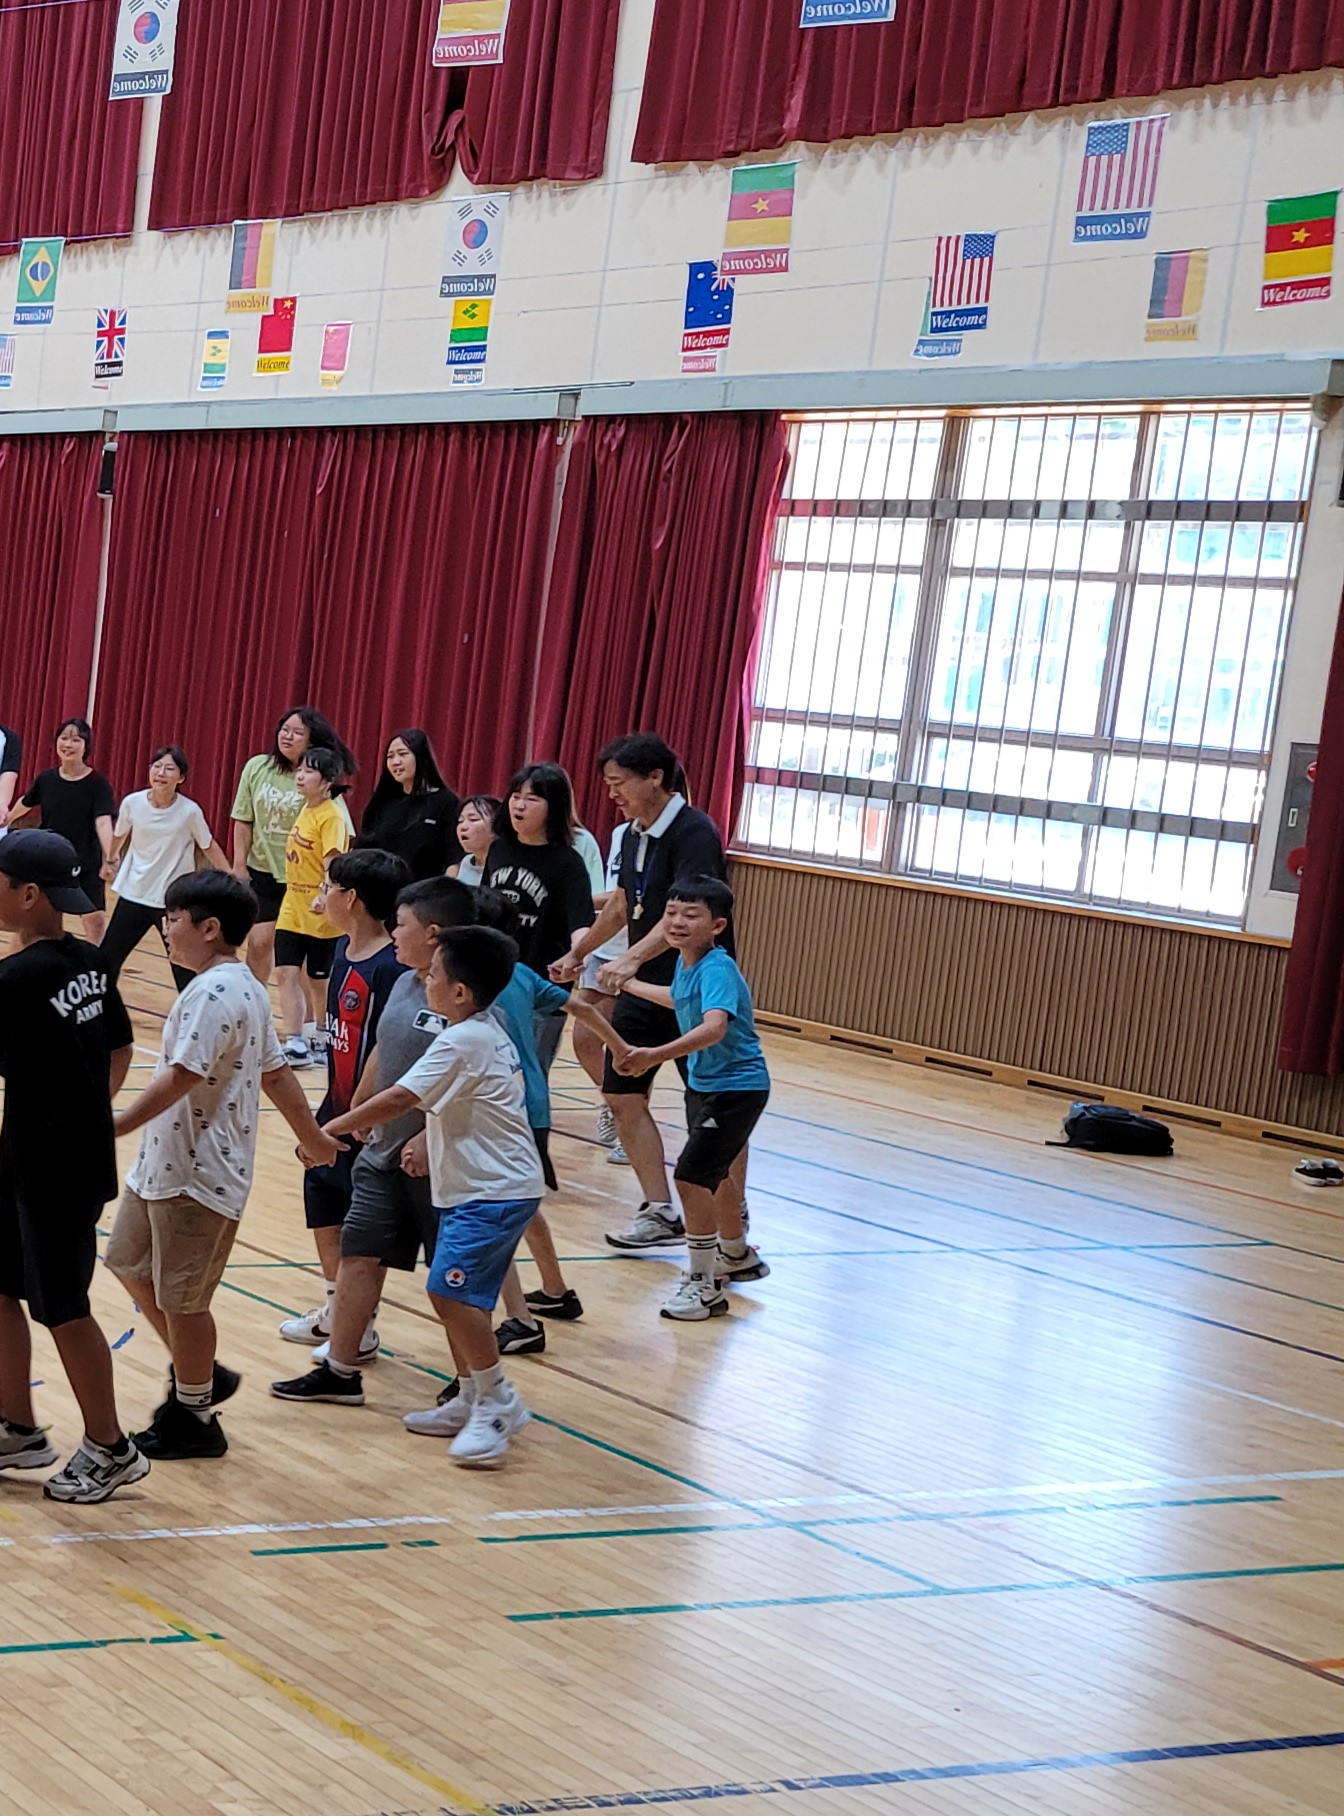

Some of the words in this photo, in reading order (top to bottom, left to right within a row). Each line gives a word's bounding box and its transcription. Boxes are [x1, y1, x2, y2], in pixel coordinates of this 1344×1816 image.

[1264, 285, 1330, 303] Welcome
[932, 313, 987, 328] Welcome
[683, 334, 729, 348] Welcome
[448, 349, 487, 362] Welcome
[257, 359, 290, 370] Welcome
[490, 866, 514, 889] EW
[514, 866, 549, 908] YORK
[76, 999, 103, 1025] ARMY
